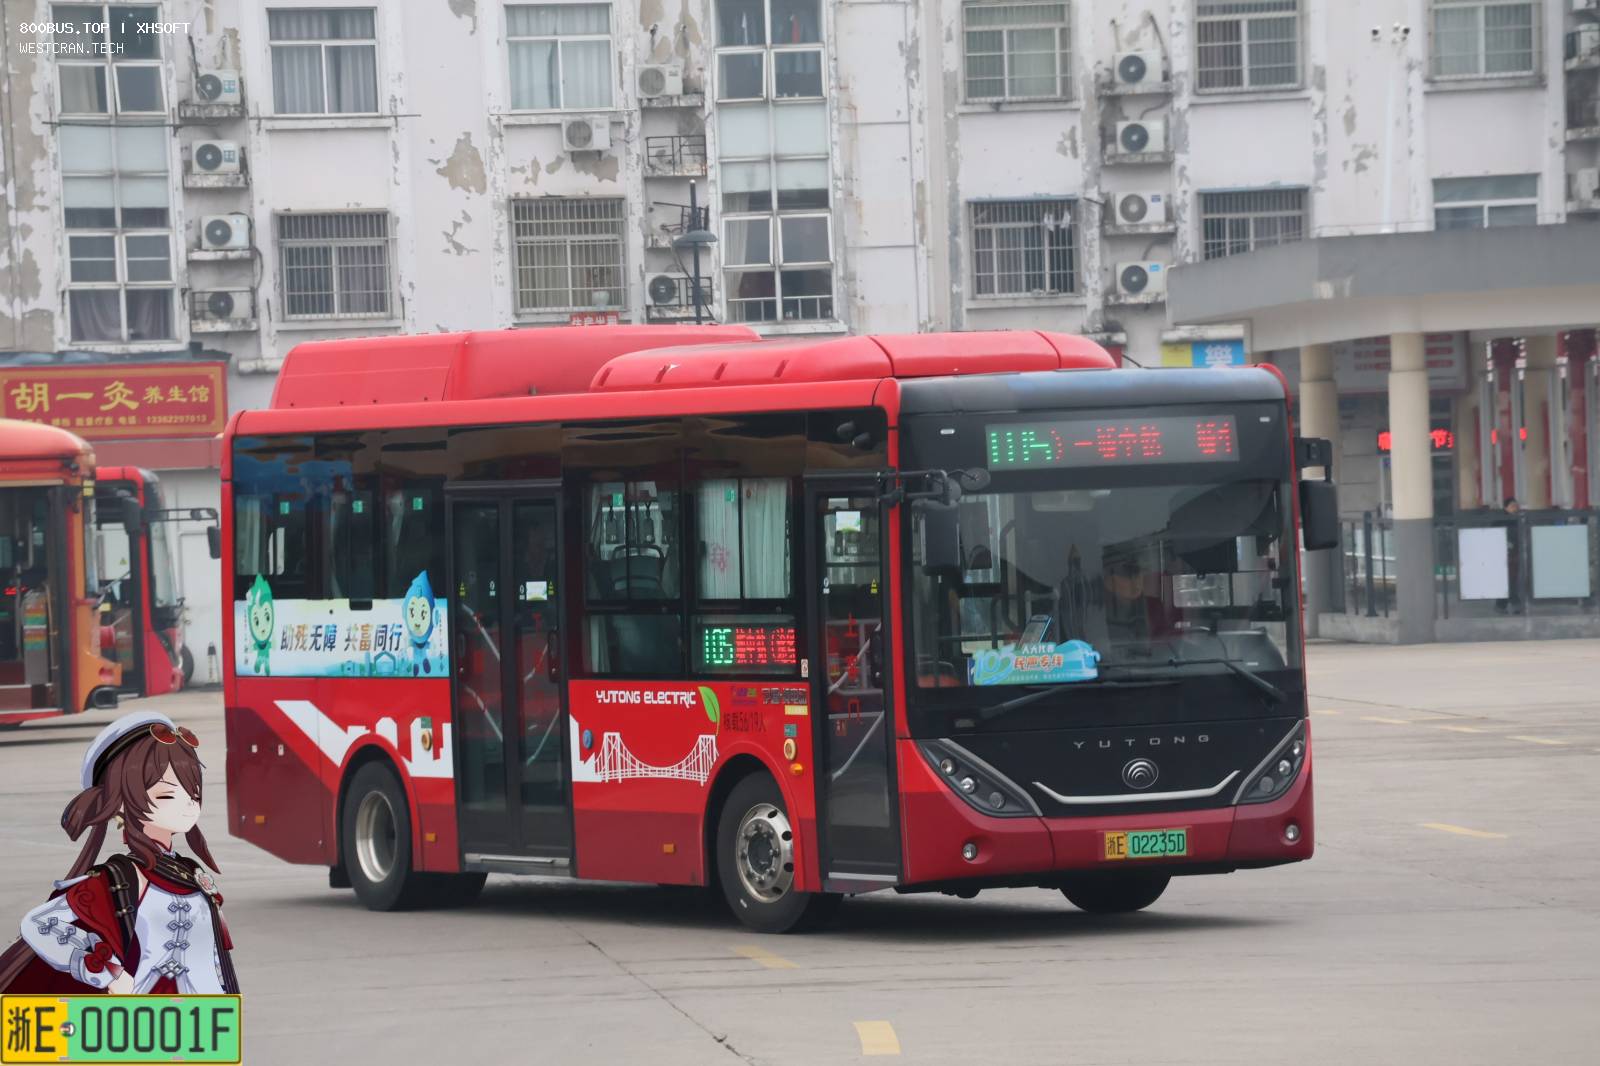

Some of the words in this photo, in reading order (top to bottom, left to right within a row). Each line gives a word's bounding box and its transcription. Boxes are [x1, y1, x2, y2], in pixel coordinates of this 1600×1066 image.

[343, 624, 403, 652] 共富同行
[595, 690, 641, 705] YUTONG
[1073, 734, 1210, 750] YUTONG
[1131, 832, 1186, 855] 02235D
